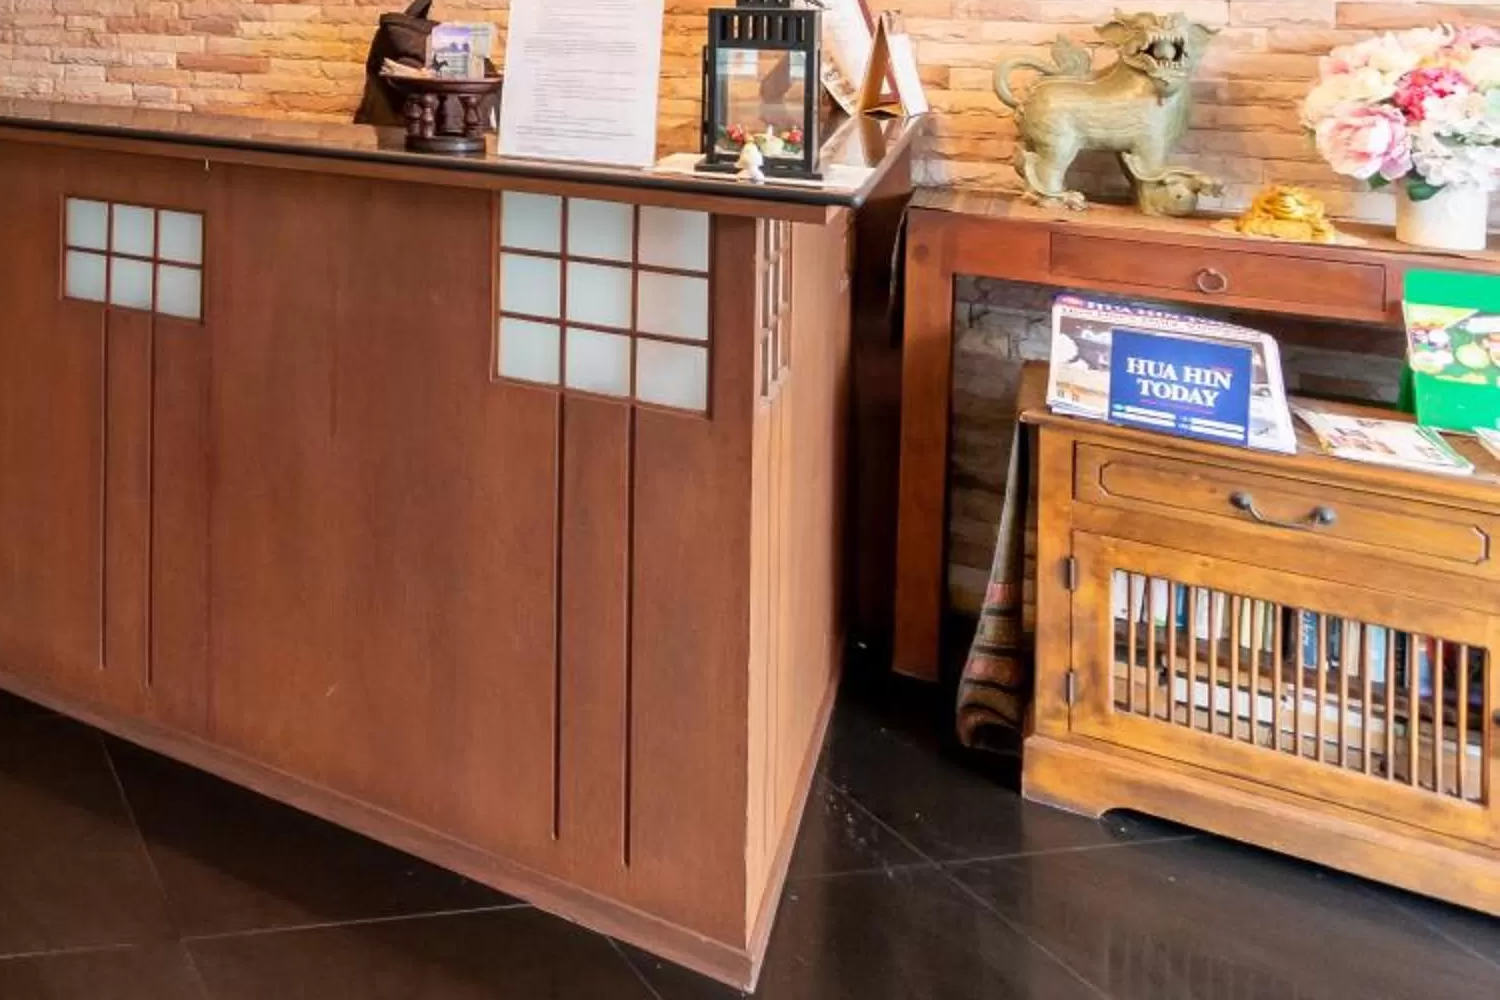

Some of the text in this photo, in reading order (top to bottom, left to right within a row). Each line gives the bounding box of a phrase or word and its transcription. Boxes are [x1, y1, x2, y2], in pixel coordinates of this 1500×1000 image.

[1126, 356, 1233, 391] HUA HIN
[1136, 377, 1220, 408] TODAY
